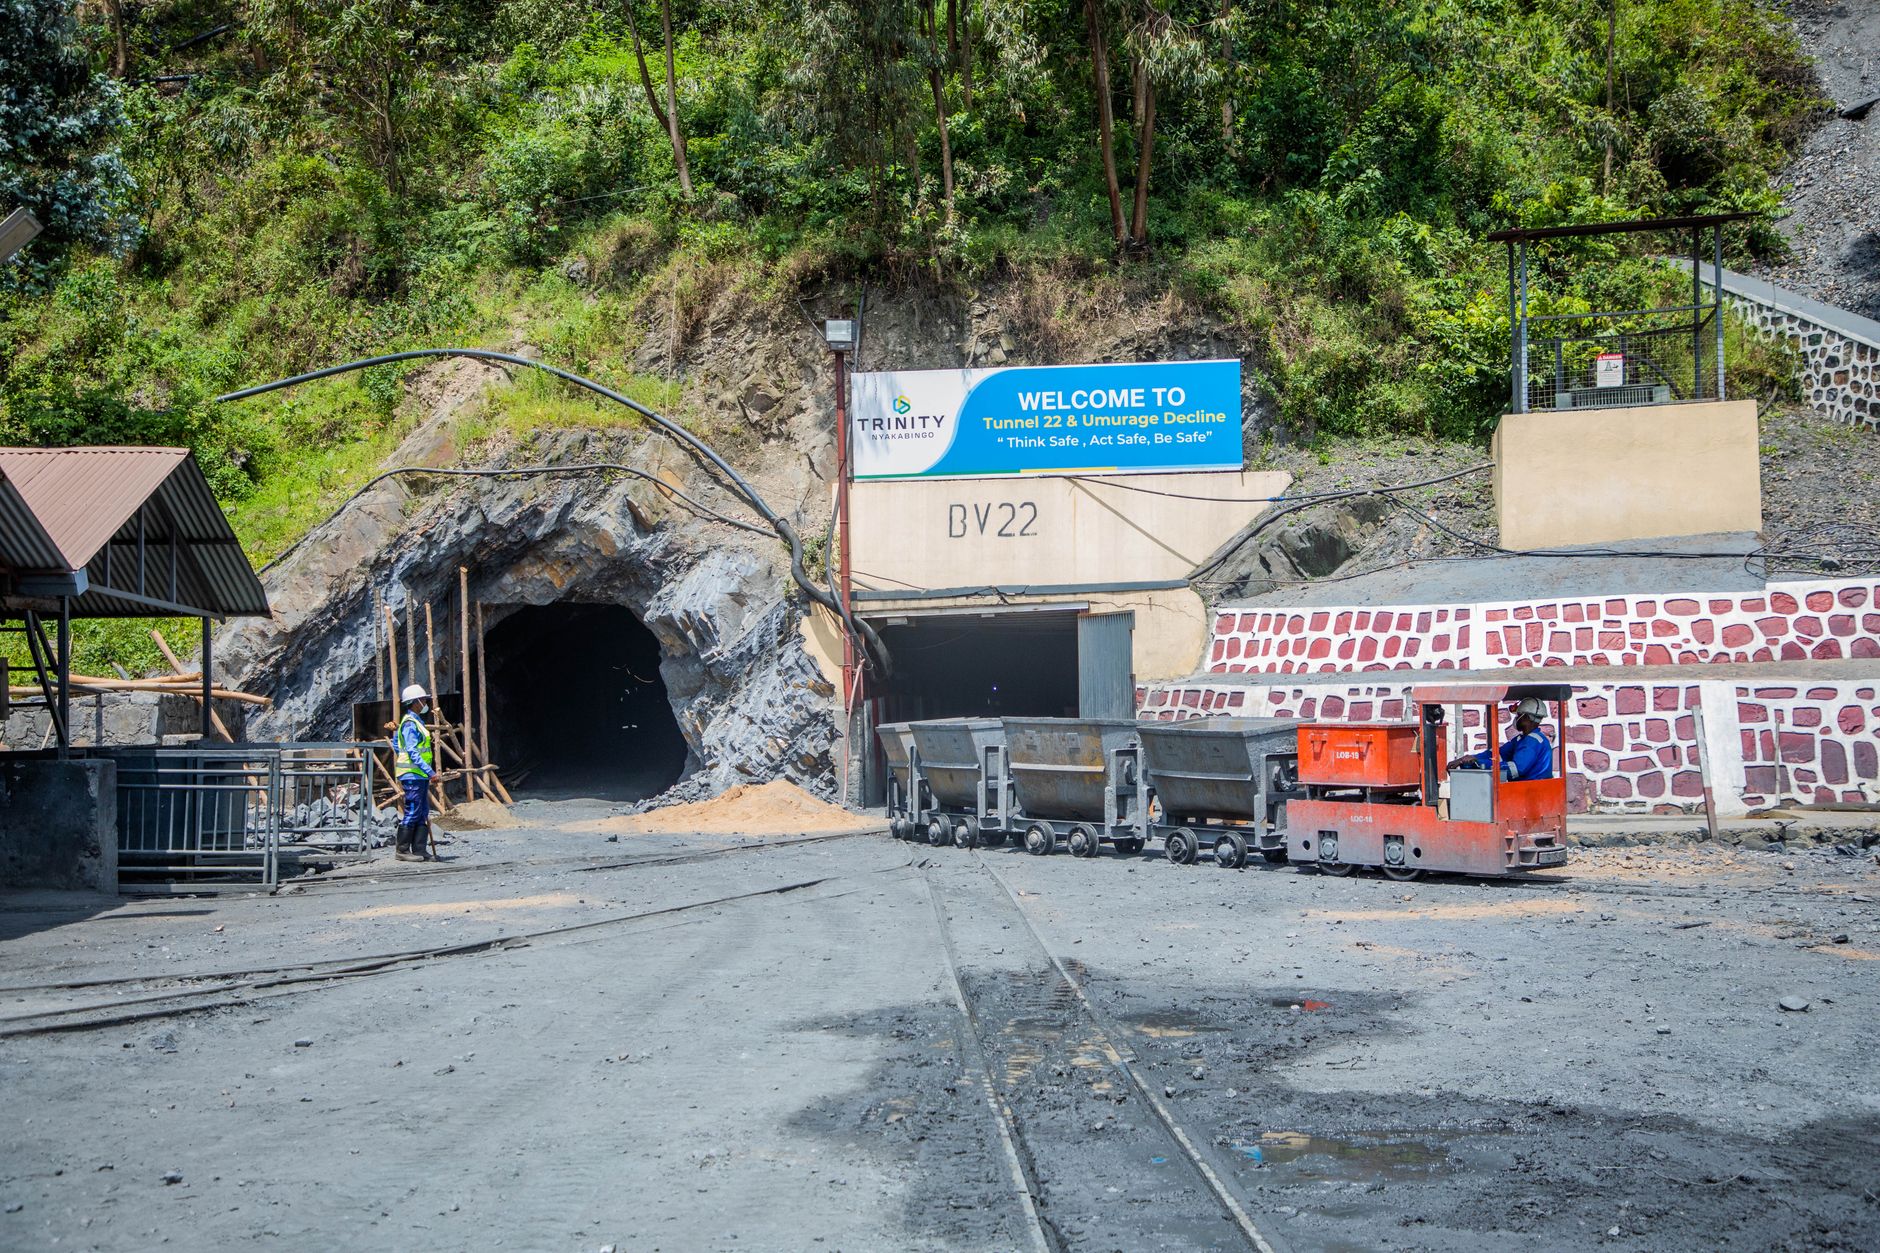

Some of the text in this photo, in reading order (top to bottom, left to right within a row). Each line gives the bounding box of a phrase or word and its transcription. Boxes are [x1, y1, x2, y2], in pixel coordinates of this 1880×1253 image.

[1018, 387, 1186, 411] WELCOME TO
[857, 415, 945, 431] TRINITY
[983, 410, 1226, 430] Tunnel 22 & Umurage Decline
[871, 431, 935, 441] NYAKABINGO
[1006, 436, 1046, 448] Think
[1089, 434, 1114, 446] Act
[1117, 433, 1151, 446] Safe,
[1154, 433, 1173, 444] Be
